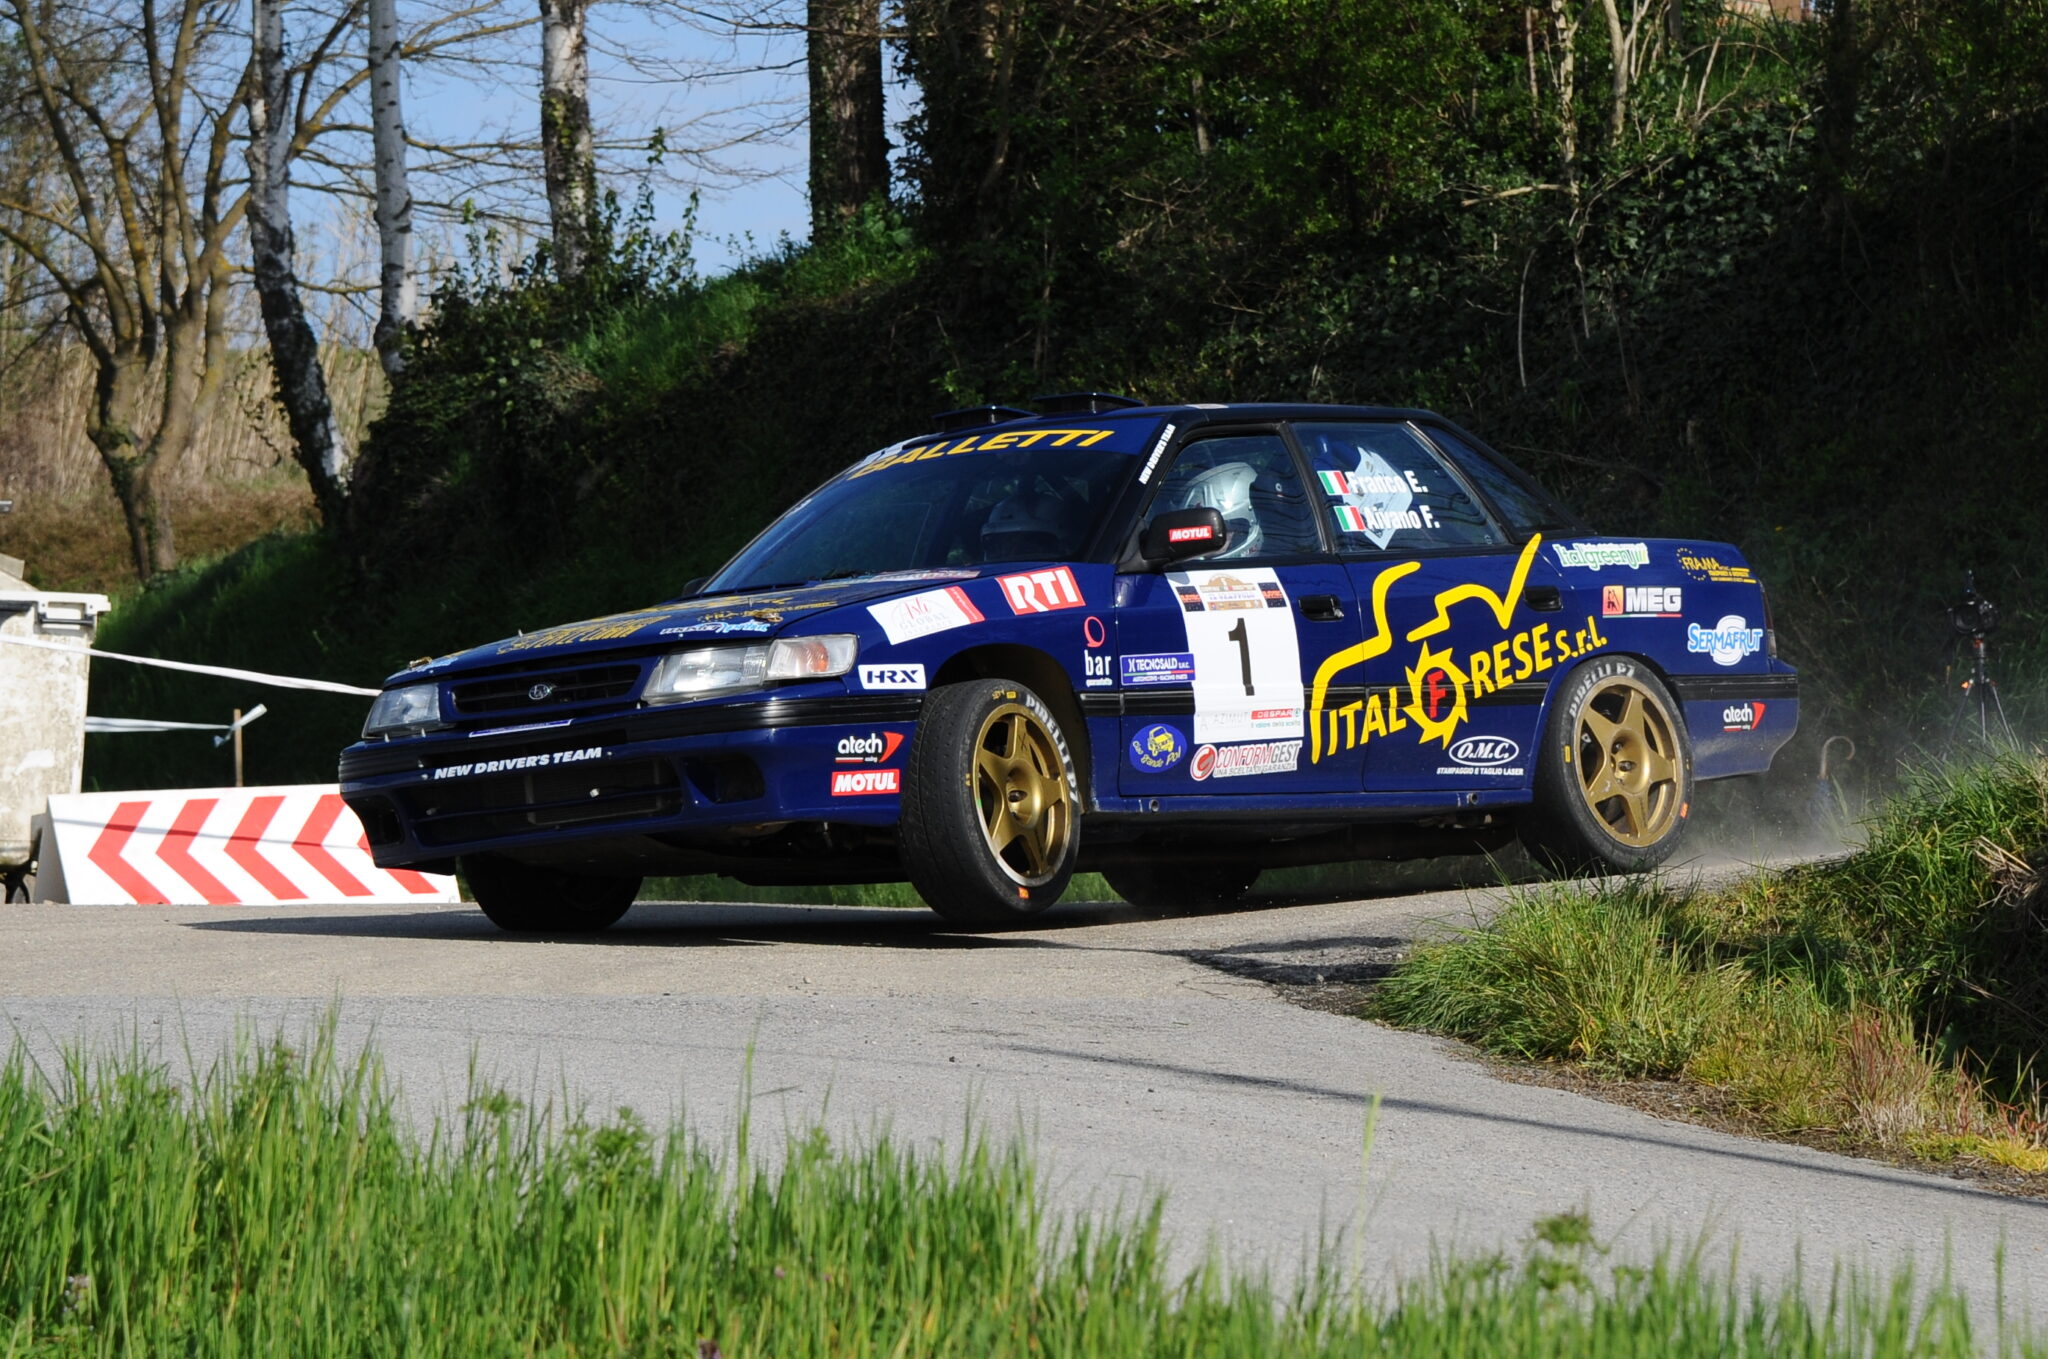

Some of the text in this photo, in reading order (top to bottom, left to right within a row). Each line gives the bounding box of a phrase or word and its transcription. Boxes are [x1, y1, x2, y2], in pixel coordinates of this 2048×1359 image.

[1344, 470, 1429, 494] Franco E.
[1363, 505, 1441, 530] Aivano F.
[1171, 527, 1210, 541] MOTUL
[1003, 569, 1079, 613] RTI
[1625, 587, 1682, 613] MEG
[899, 611, 950, 630] GLOBAL
[1687, 623, 1763, 653] SERMAFRUT
[1084, 649, 1112, 677] bar
[1136, 657, 1178, 671] TECNOSALD
[1227, 617, 1255, 696] 1
[866, 669, 919, 685] HRX
[1569, 662, 1612, 718] PIRELLI
[1256, 709, 1293, 719] DESPAR
[1722, 702, 1753, 723] atech
[1025, 694, 1071, 765] PIRELLI
[837, 732, 883, 754] atech
[1456, 742, 1510, 759] O.M.C.
[434, 746, 603, 780] NEW DRIVER'S TEAM
[1503, 767, 1524, 775] LASER
[834, 771, 897, 793] MOTUL
